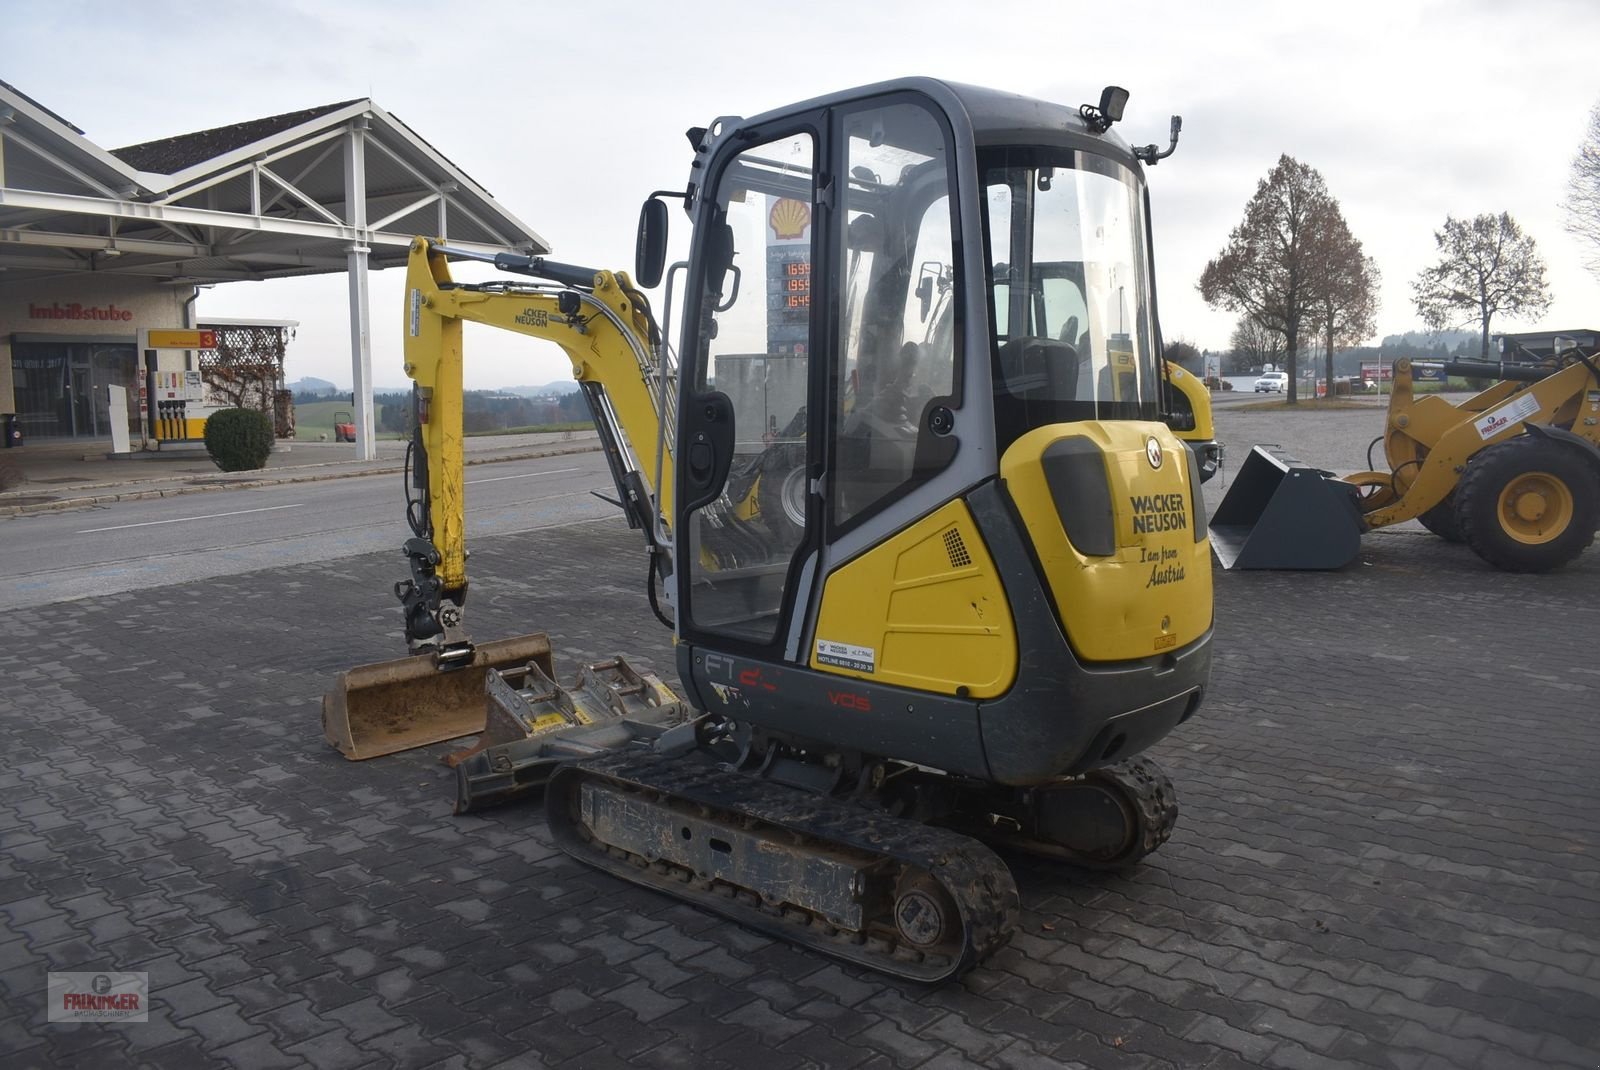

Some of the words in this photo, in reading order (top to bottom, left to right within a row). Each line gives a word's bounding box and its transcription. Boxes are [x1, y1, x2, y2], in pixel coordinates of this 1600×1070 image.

[29, 303, 133, 321] Imbißstube
[515, 315, 547, 327] NEUSON
[204, 334, 213, 346] 3
[1130, 494, 1184, 514] WACKER
[1133, 512, 1186, 534] NEUSON
[1140, 548, 1147, 563] I
[1148, 552, 1160, 562] am
[1161, 545, 1177, 564] from
[1146, 562, 1186, 589] Austria
[818, 656, 839, 665] HOTLINE
